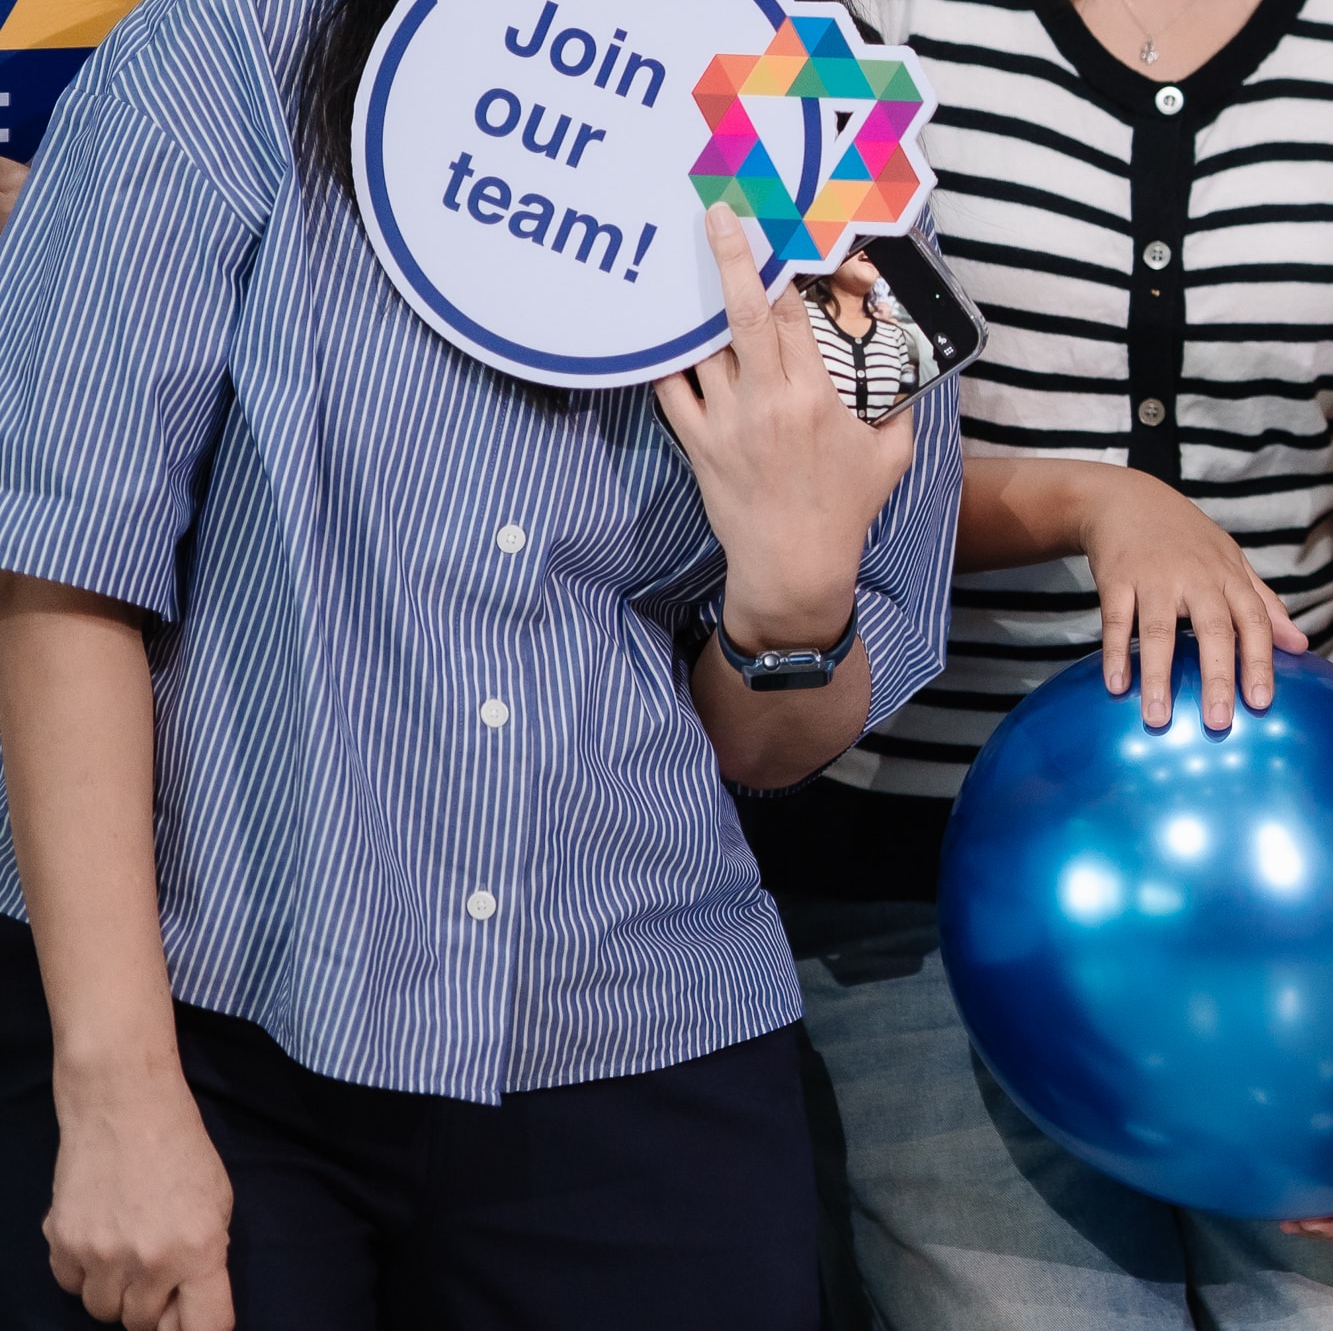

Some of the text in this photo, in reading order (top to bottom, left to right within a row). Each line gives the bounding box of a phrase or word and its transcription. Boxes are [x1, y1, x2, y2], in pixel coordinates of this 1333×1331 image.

[504, 0, 667, 108] Join
[473, 86, 607, 169] our
[441, 152, 659, 284] team!
